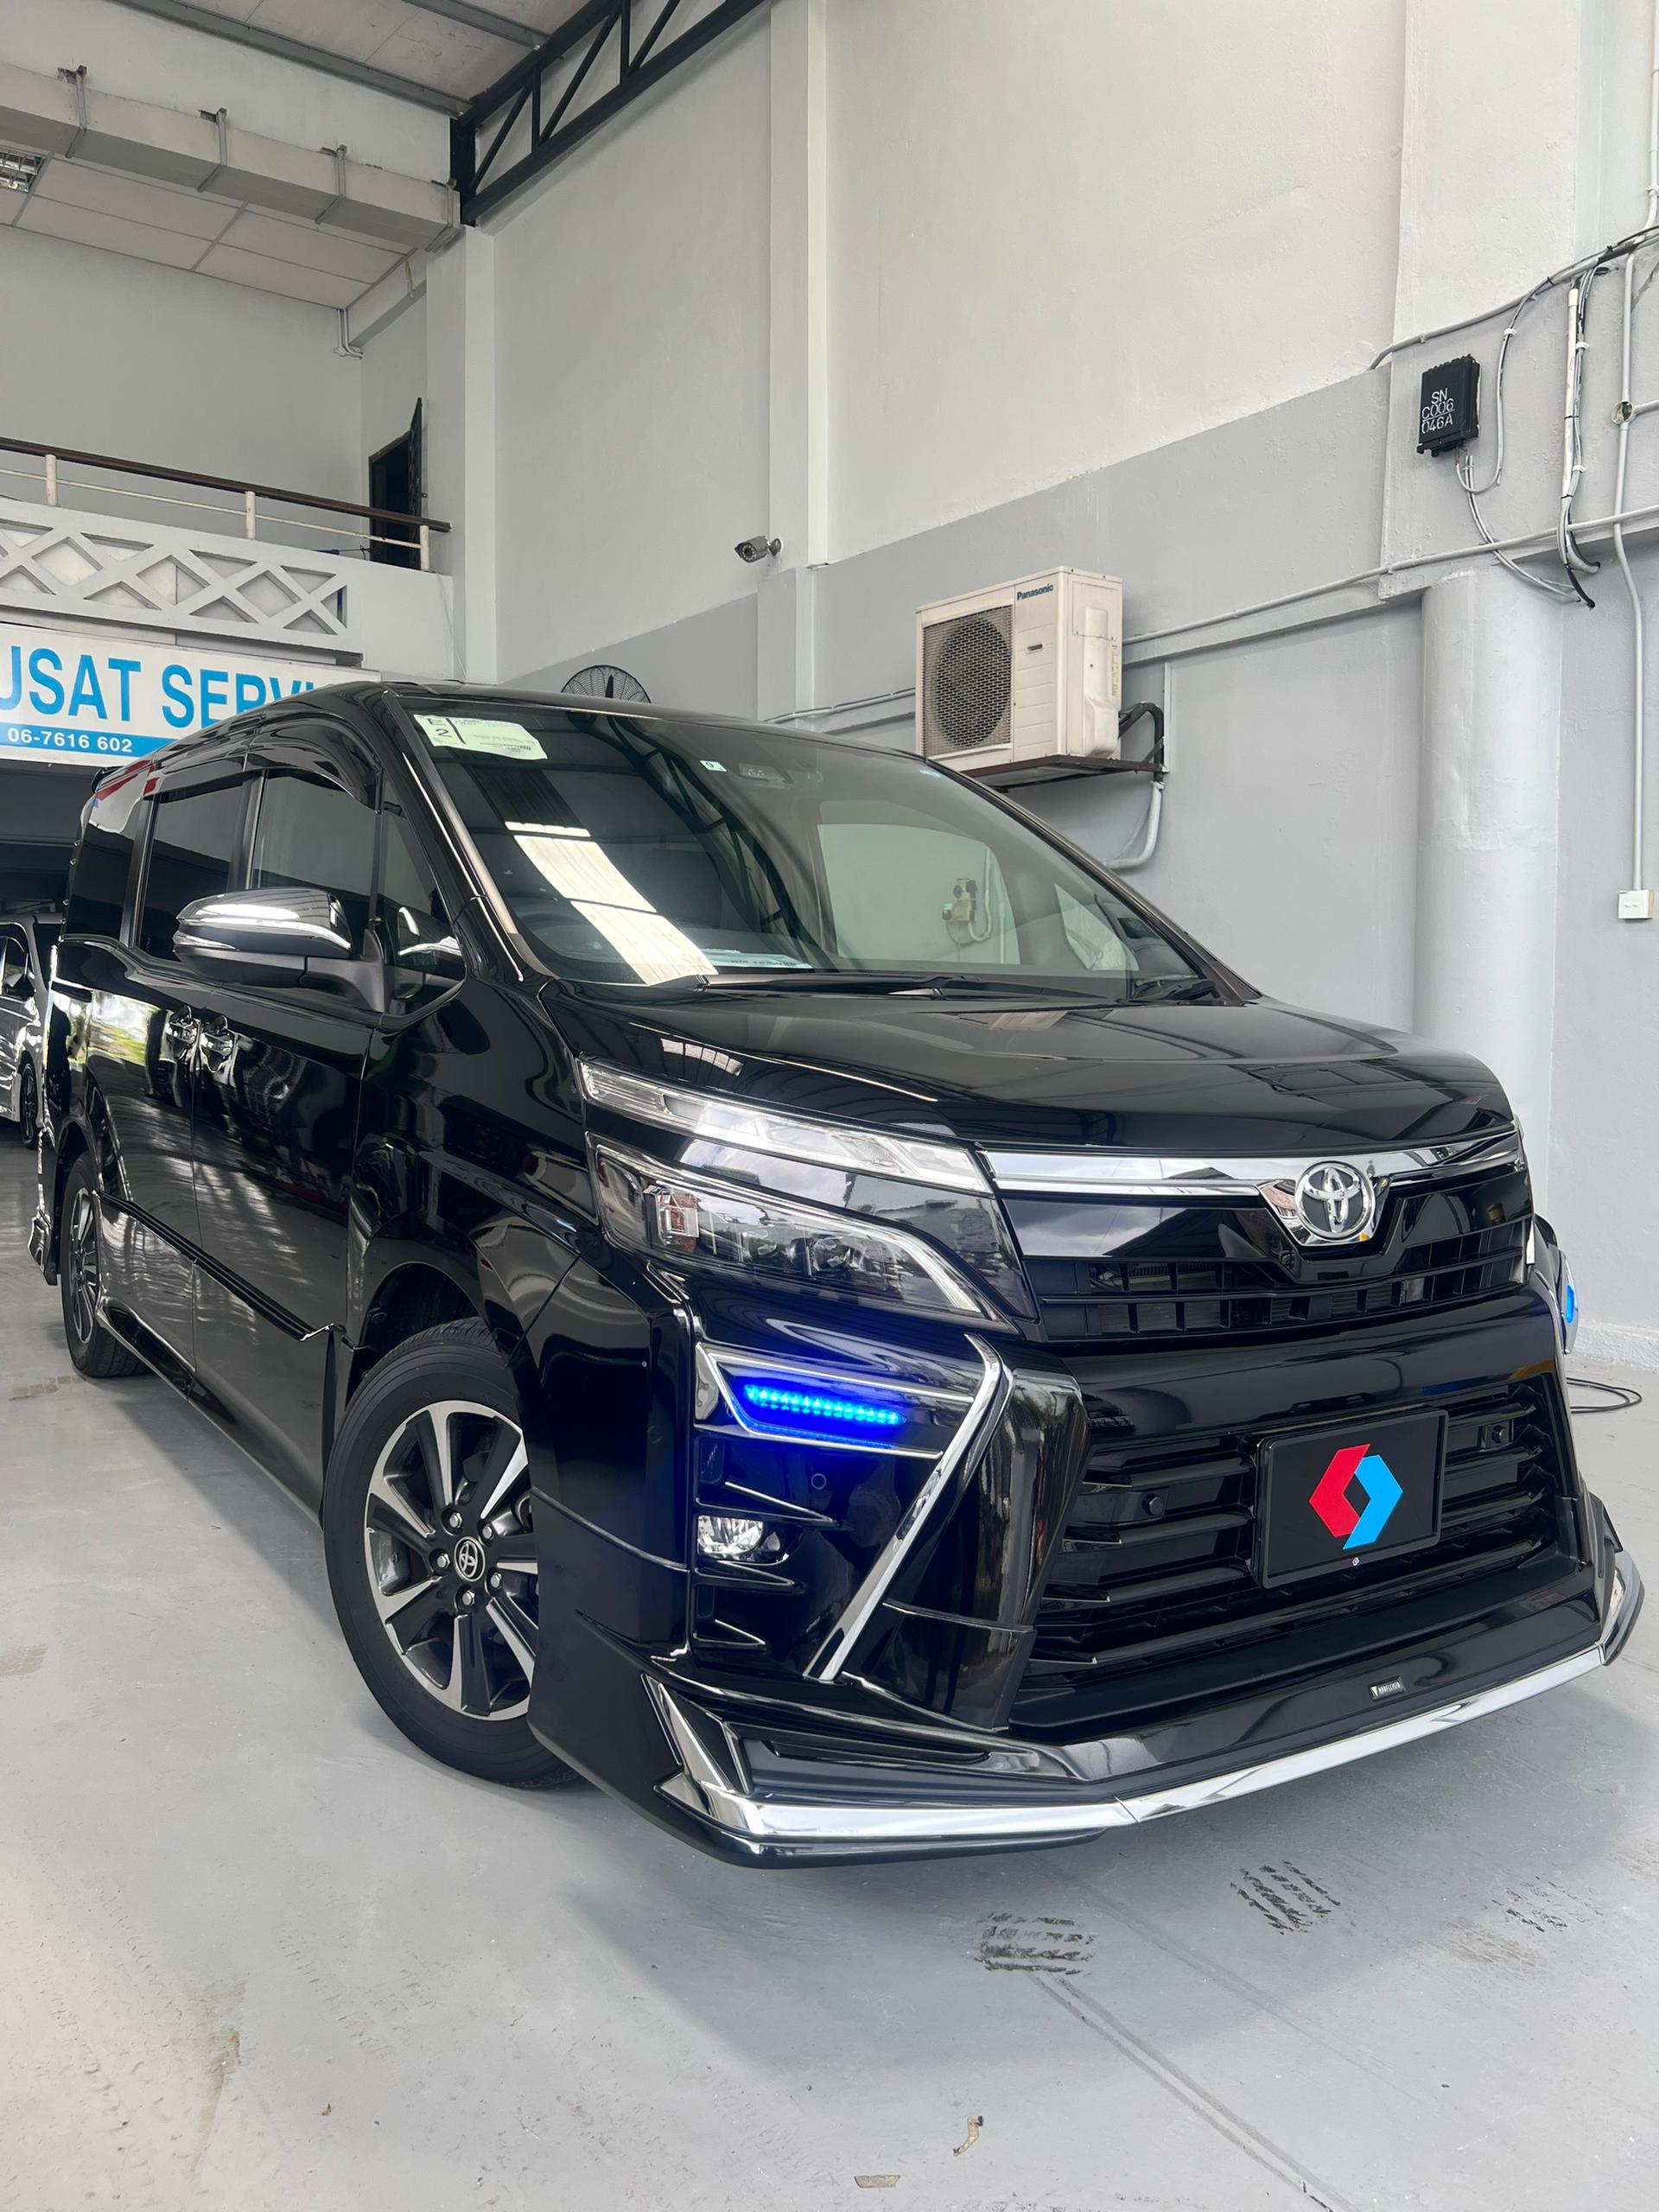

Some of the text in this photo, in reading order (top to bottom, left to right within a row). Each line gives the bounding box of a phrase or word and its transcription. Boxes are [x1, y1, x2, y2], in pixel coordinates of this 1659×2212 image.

[1431, 388, 1447, 404] SN
[1421, 398, 1453, 420] C006
[1421, 413, 1453, 434] 046A
[1017, 583, 1053, 601] Panasonic
[162, 664, 314, 729] SER
[8, 728, 132, 753] 06-7616 602
